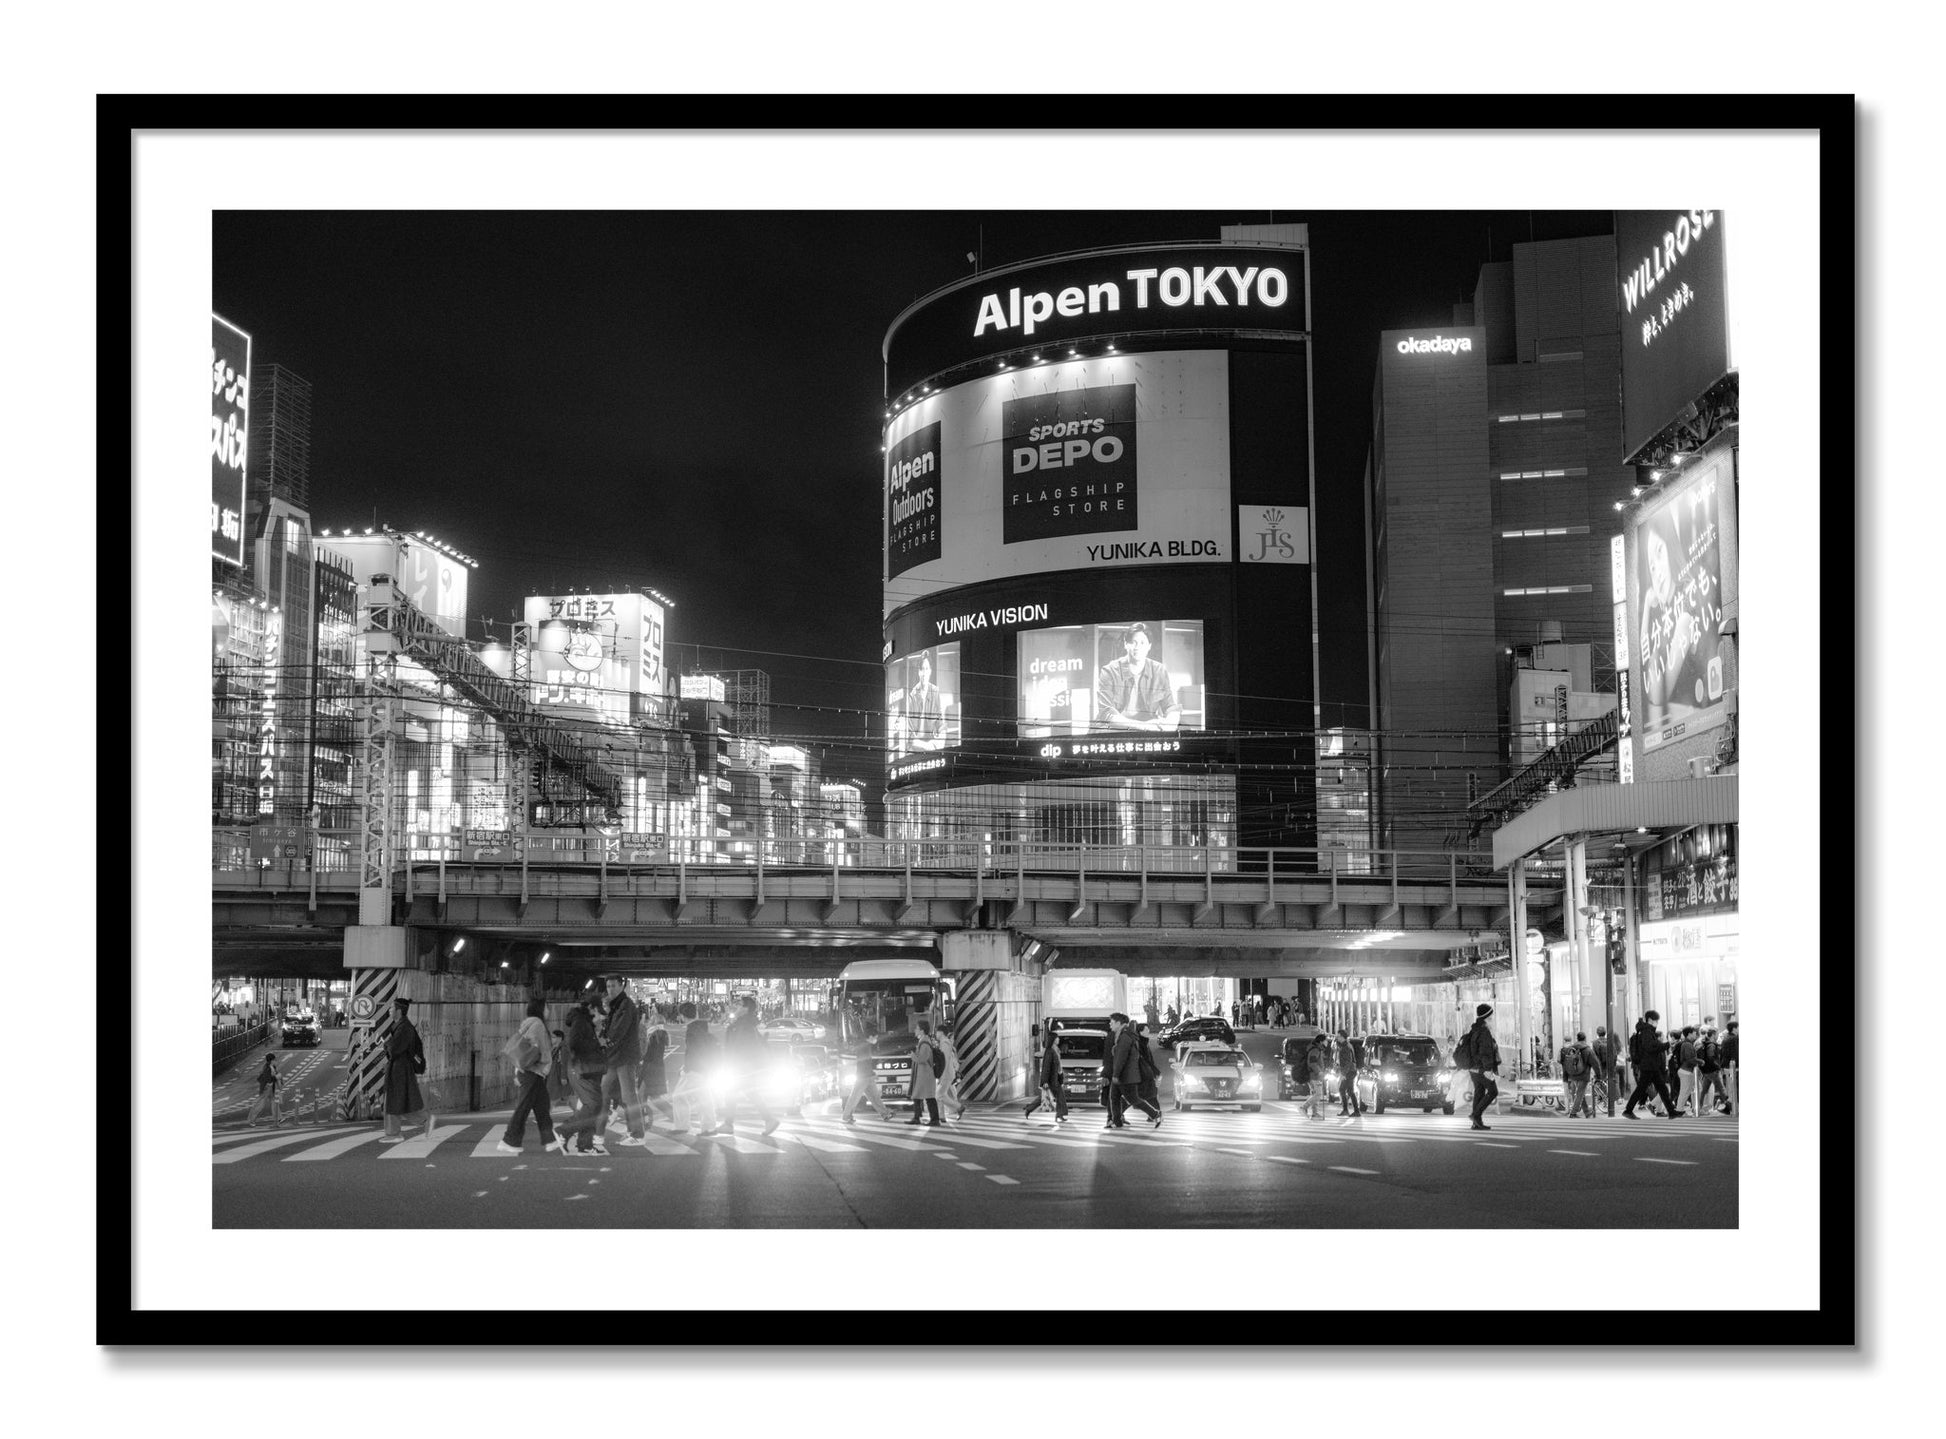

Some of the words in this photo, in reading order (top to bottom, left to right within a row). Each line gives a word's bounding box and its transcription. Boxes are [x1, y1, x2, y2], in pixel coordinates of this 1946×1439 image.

[973, 280, 1120, 337] Alpen
[1127, 266, 1288, 309] TOKYO
[1397, 335, 1472, 354] okadaya
[212, 348, 248, 409] チンコ
[1028, 418, 1105, 441] SPORTS
[1012, 435, 1124, 474] DEPO
[890, 451, 935, 495] Alpen
[892, 487, 934, 526] Outdoors
[1013, 482, 1125, 505] FLAGSHIP
[1052, 499, 1125, 517] STORE
[890, 514, 935, 546] FLAGSHIP
[902, 530, 935, 553] STORE
[1087, 538, 1164, 562] YUNIKA
[1168, 539, 1222, 558] BLDG.
[550, 598, 616, 617] プロミス
[935, 610, 988, 636] YUNIKA
[990, 603, 1048, 624] VISION
[1641, 566, 1718, 666] 自分本位でも、
[1643, 602, 1721, 695] いいじゃない。
[1030, 657, 1083, 674] dream
[1040, 743, 1062, 759] dip
[1072, 741, 1180, 755] 夢を叶える仕事に出会おう
